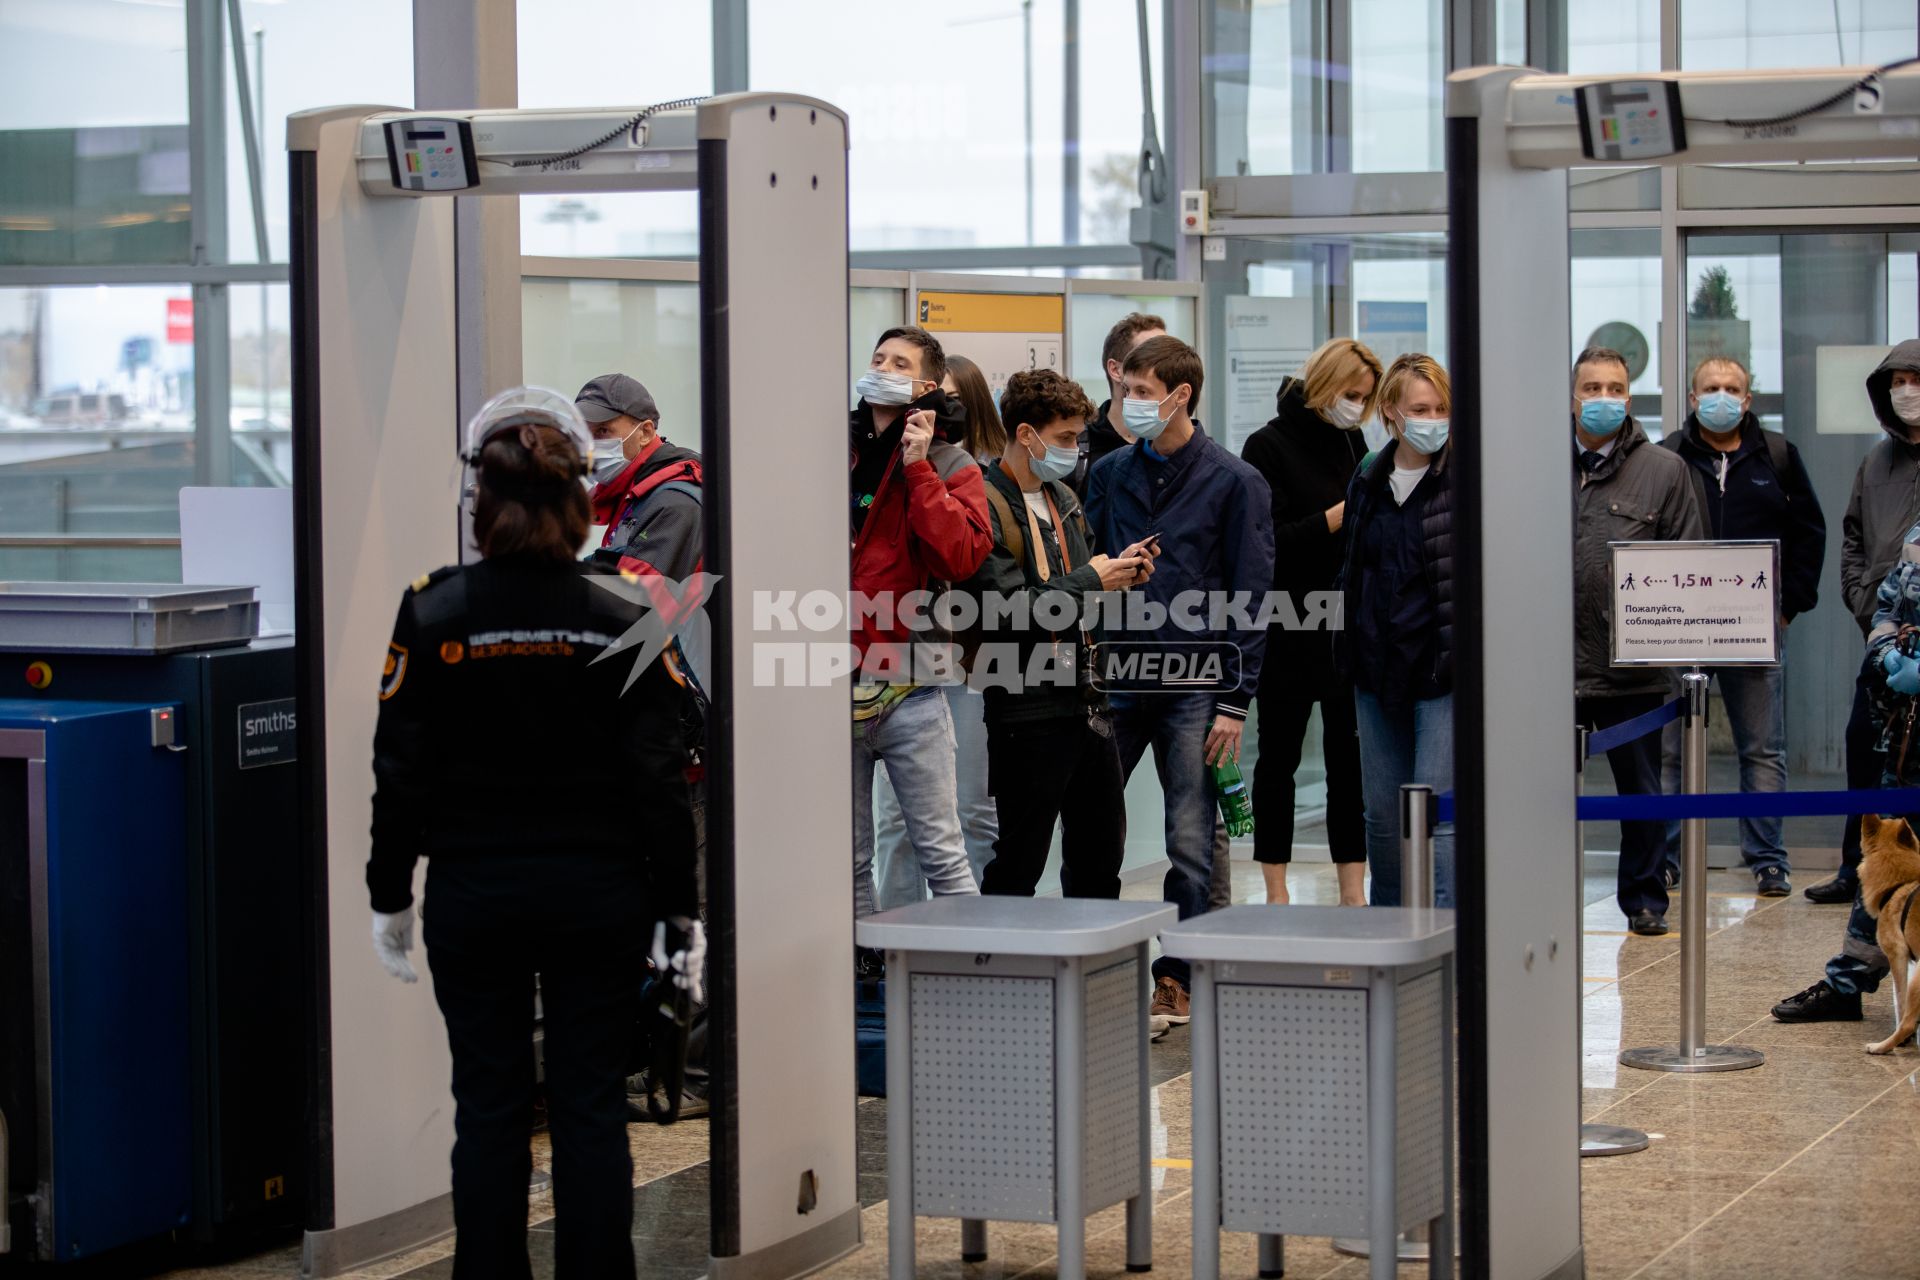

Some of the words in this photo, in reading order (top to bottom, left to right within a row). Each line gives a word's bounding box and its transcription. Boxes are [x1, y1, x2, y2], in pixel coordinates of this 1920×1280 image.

[1029, 348, 1036, 369] 3
[1672, 573, 1696, 589] 1,5
[1700, 576, 1712, 587] м
[1625, 604, 1685, 615] Пожалуйста,
[1625, 617, 1682, 626] соблюдайте
[1647, 638, 1661, 646] keep
[1678, 637, 1703, 645] distance
[245, 711, 297, 737] smiths
